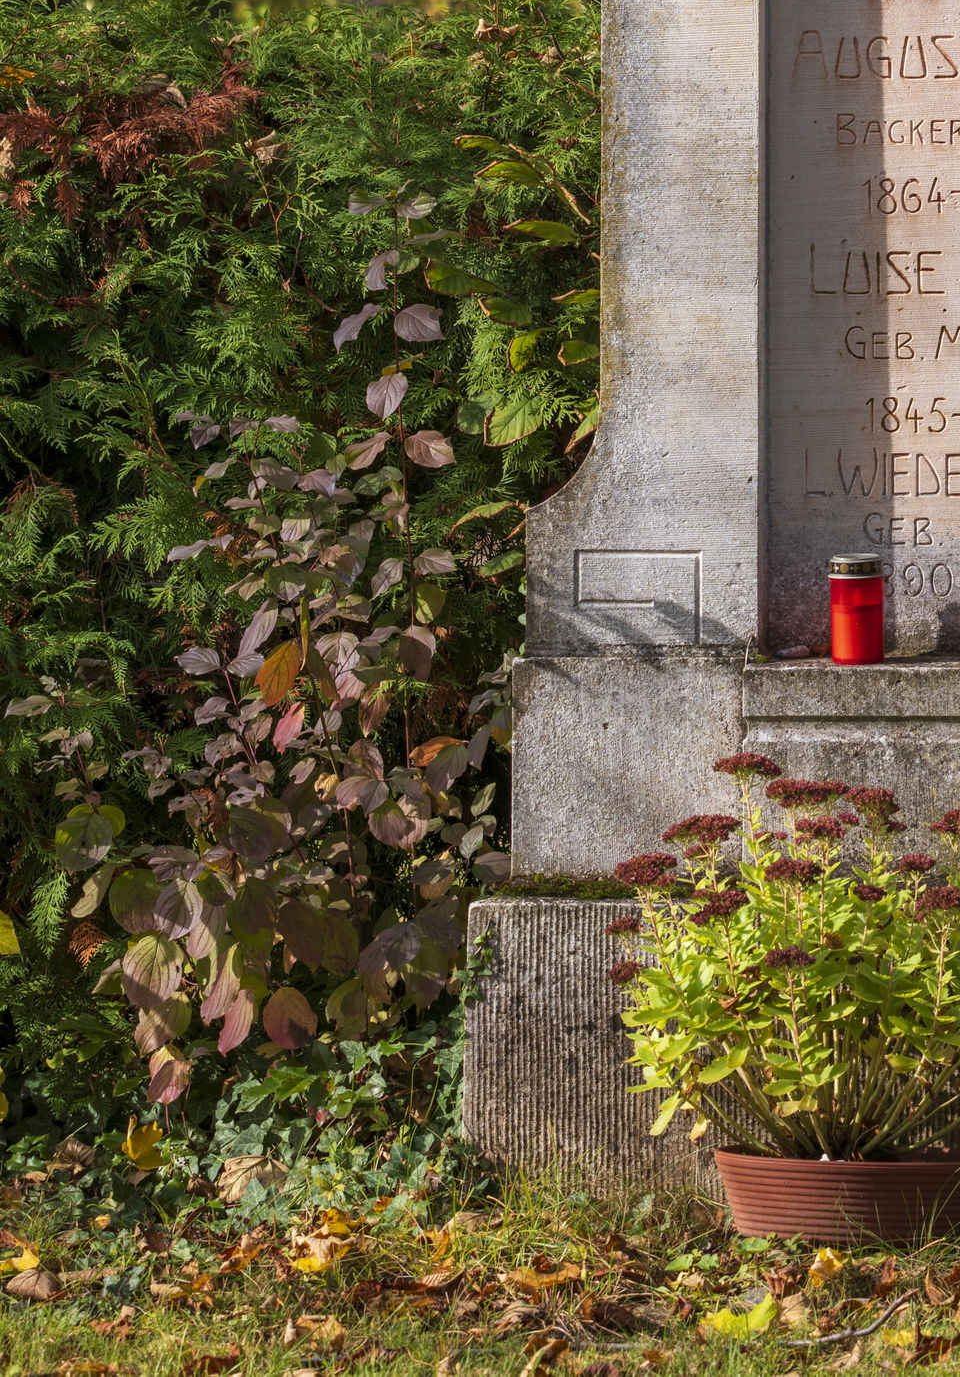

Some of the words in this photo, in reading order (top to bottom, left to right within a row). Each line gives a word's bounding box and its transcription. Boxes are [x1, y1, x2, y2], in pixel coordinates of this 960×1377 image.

[809, 242, 946, 296] LUISE
[844, 325, 926, 362] GEB.
[862, 512, 944, 549] GEB.
